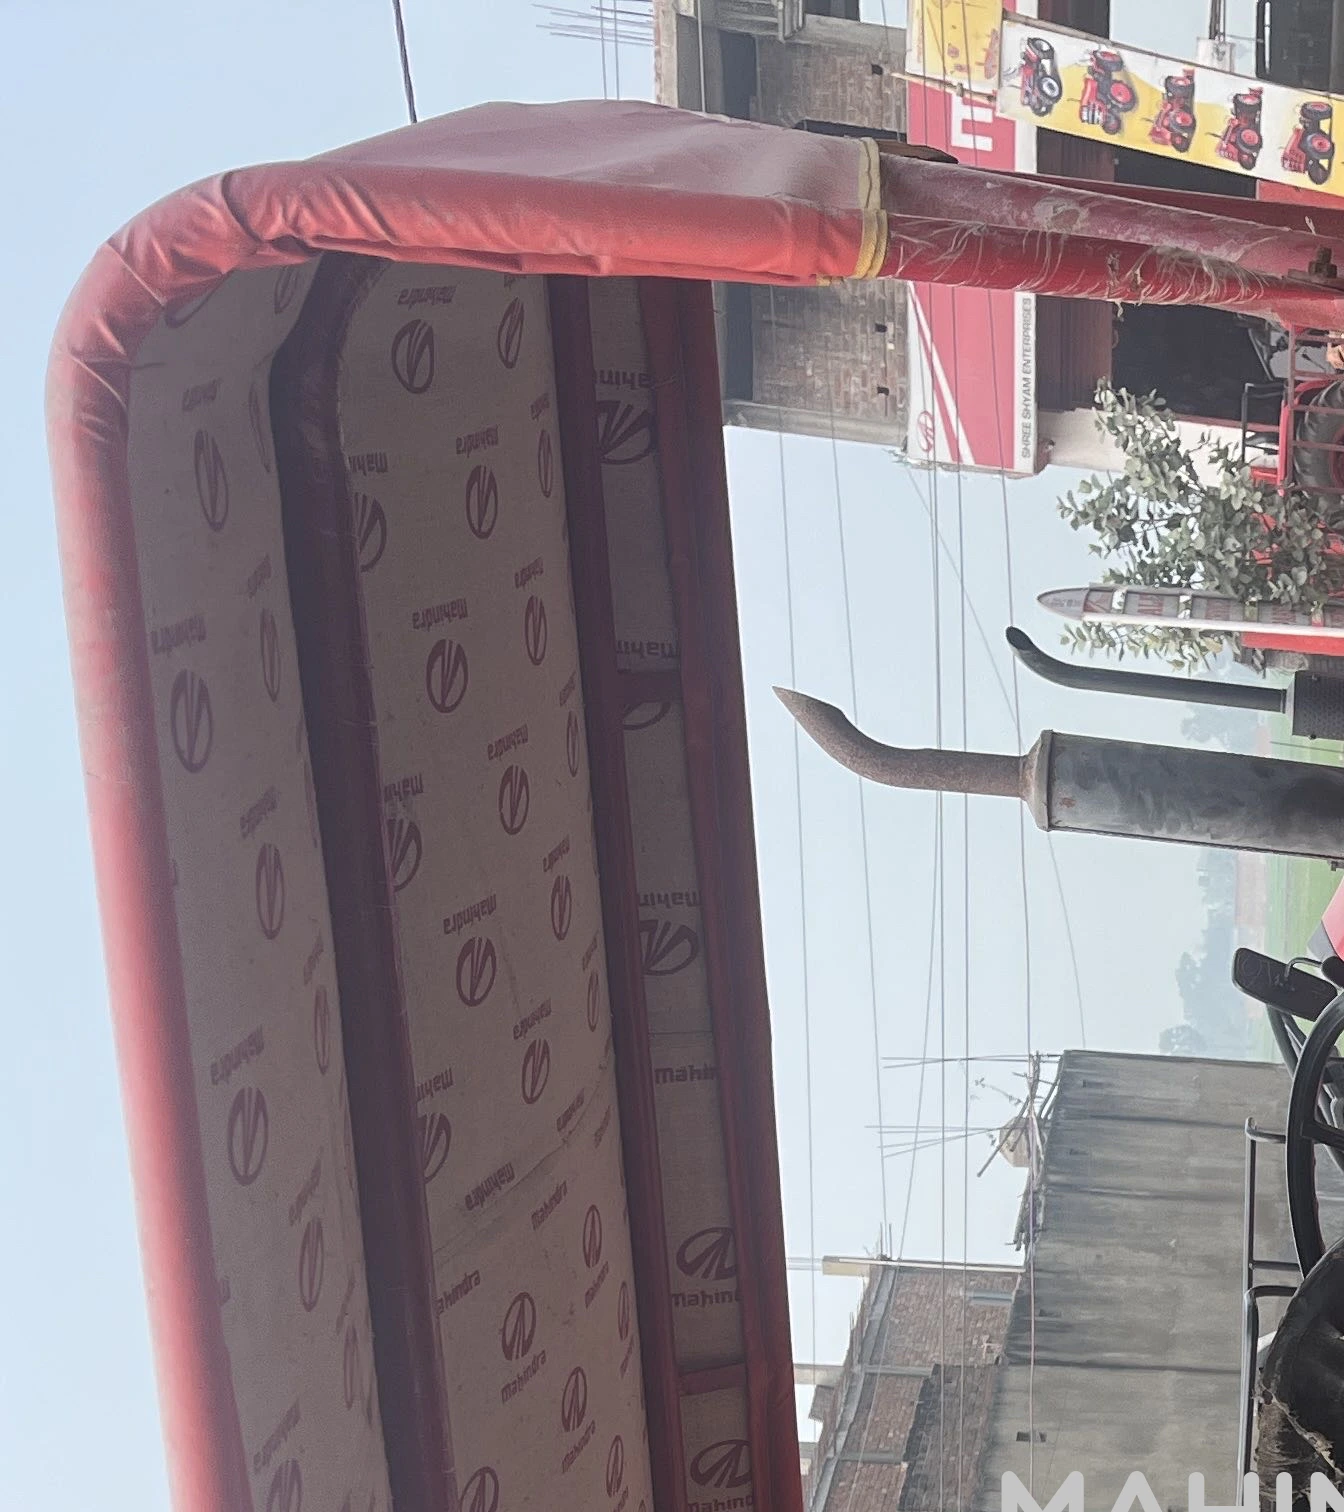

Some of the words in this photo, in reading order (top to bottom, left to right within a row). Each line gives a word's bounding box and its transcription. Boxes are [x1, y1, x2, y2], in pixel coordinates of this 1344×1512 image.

[1021, 297, 1032, 375] ENTERPRISES
[1021, 377, 1032, 420] SHYAM
[1021, 422, 1032, 459] SHREE
